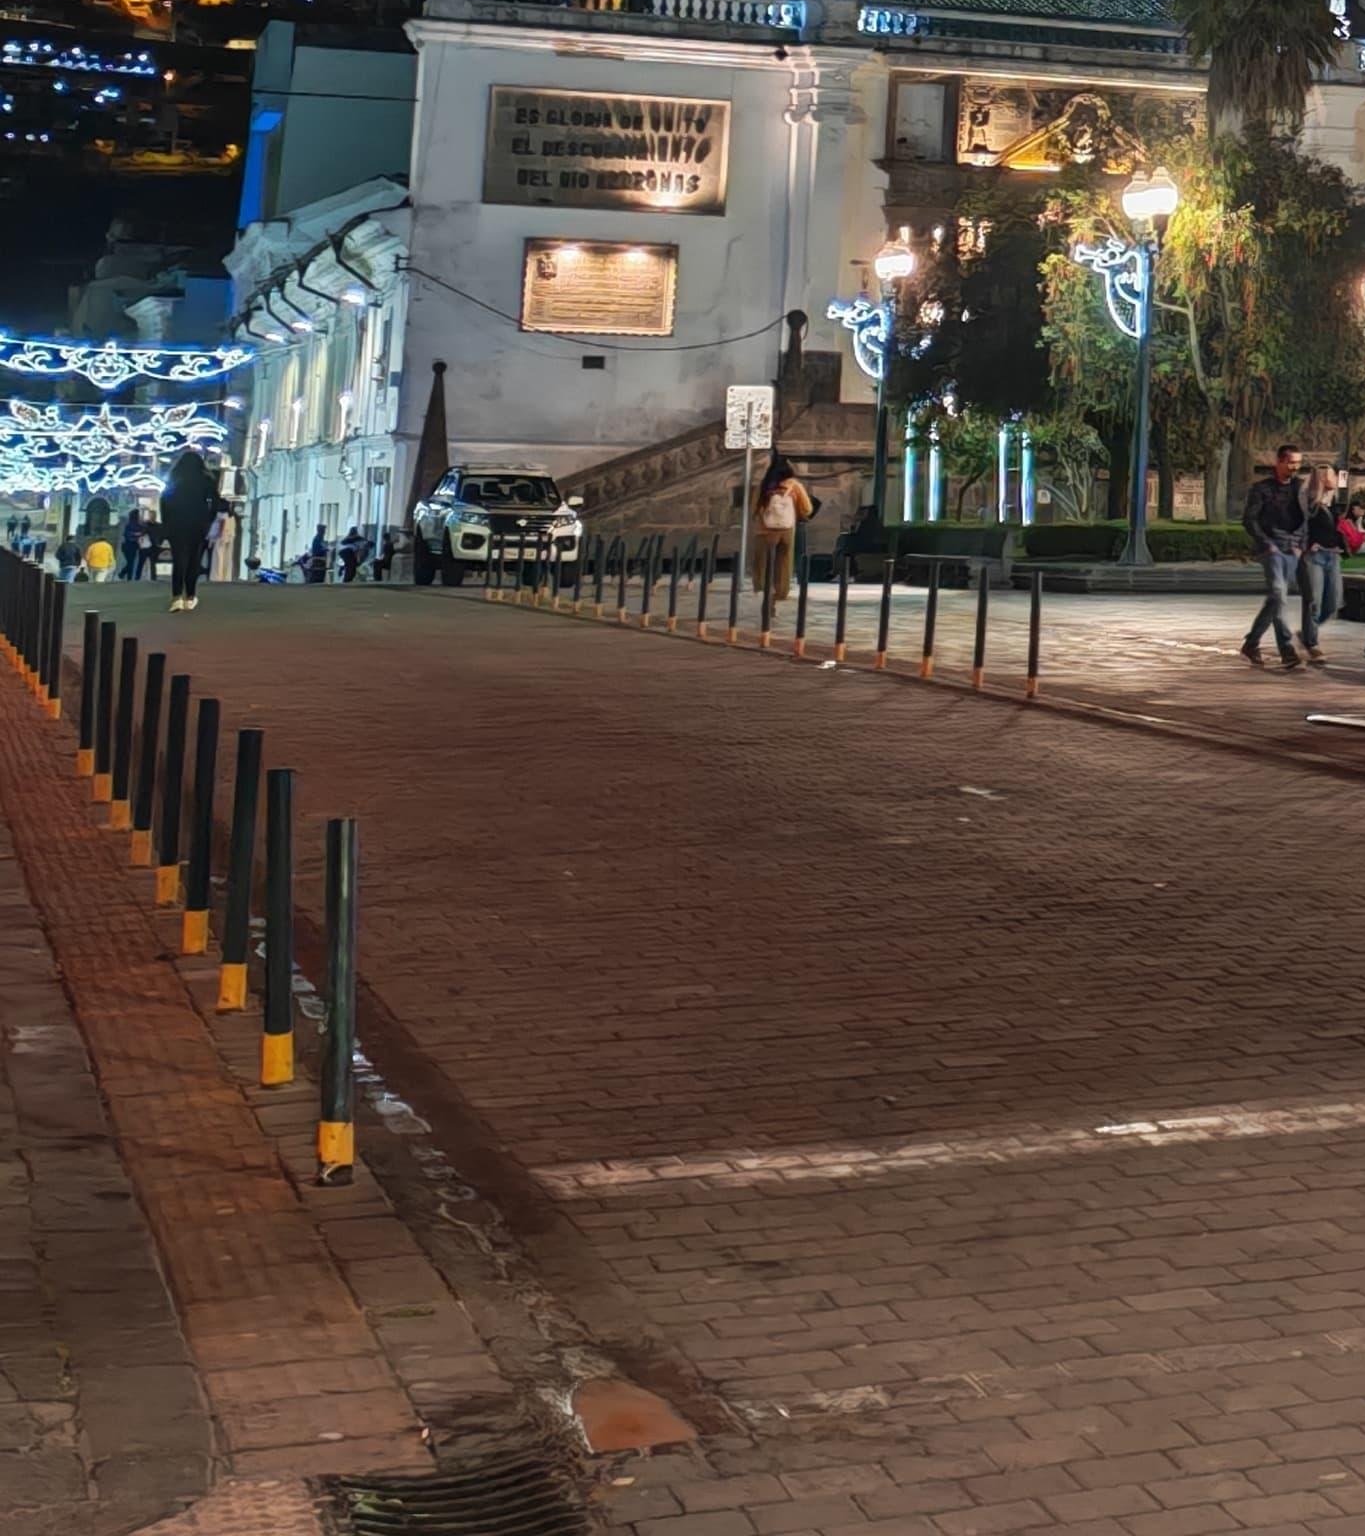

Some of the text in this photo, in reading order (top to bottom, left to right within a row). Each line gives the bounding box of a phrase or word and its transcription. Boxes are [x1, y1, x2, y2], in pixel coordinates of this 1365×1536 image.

[515, 108, 539, 124] ES
[547, 109, 612, 128] GLORIA
[512, 135, 535, 155] EL
[517, 168, 552, 187] DEL
